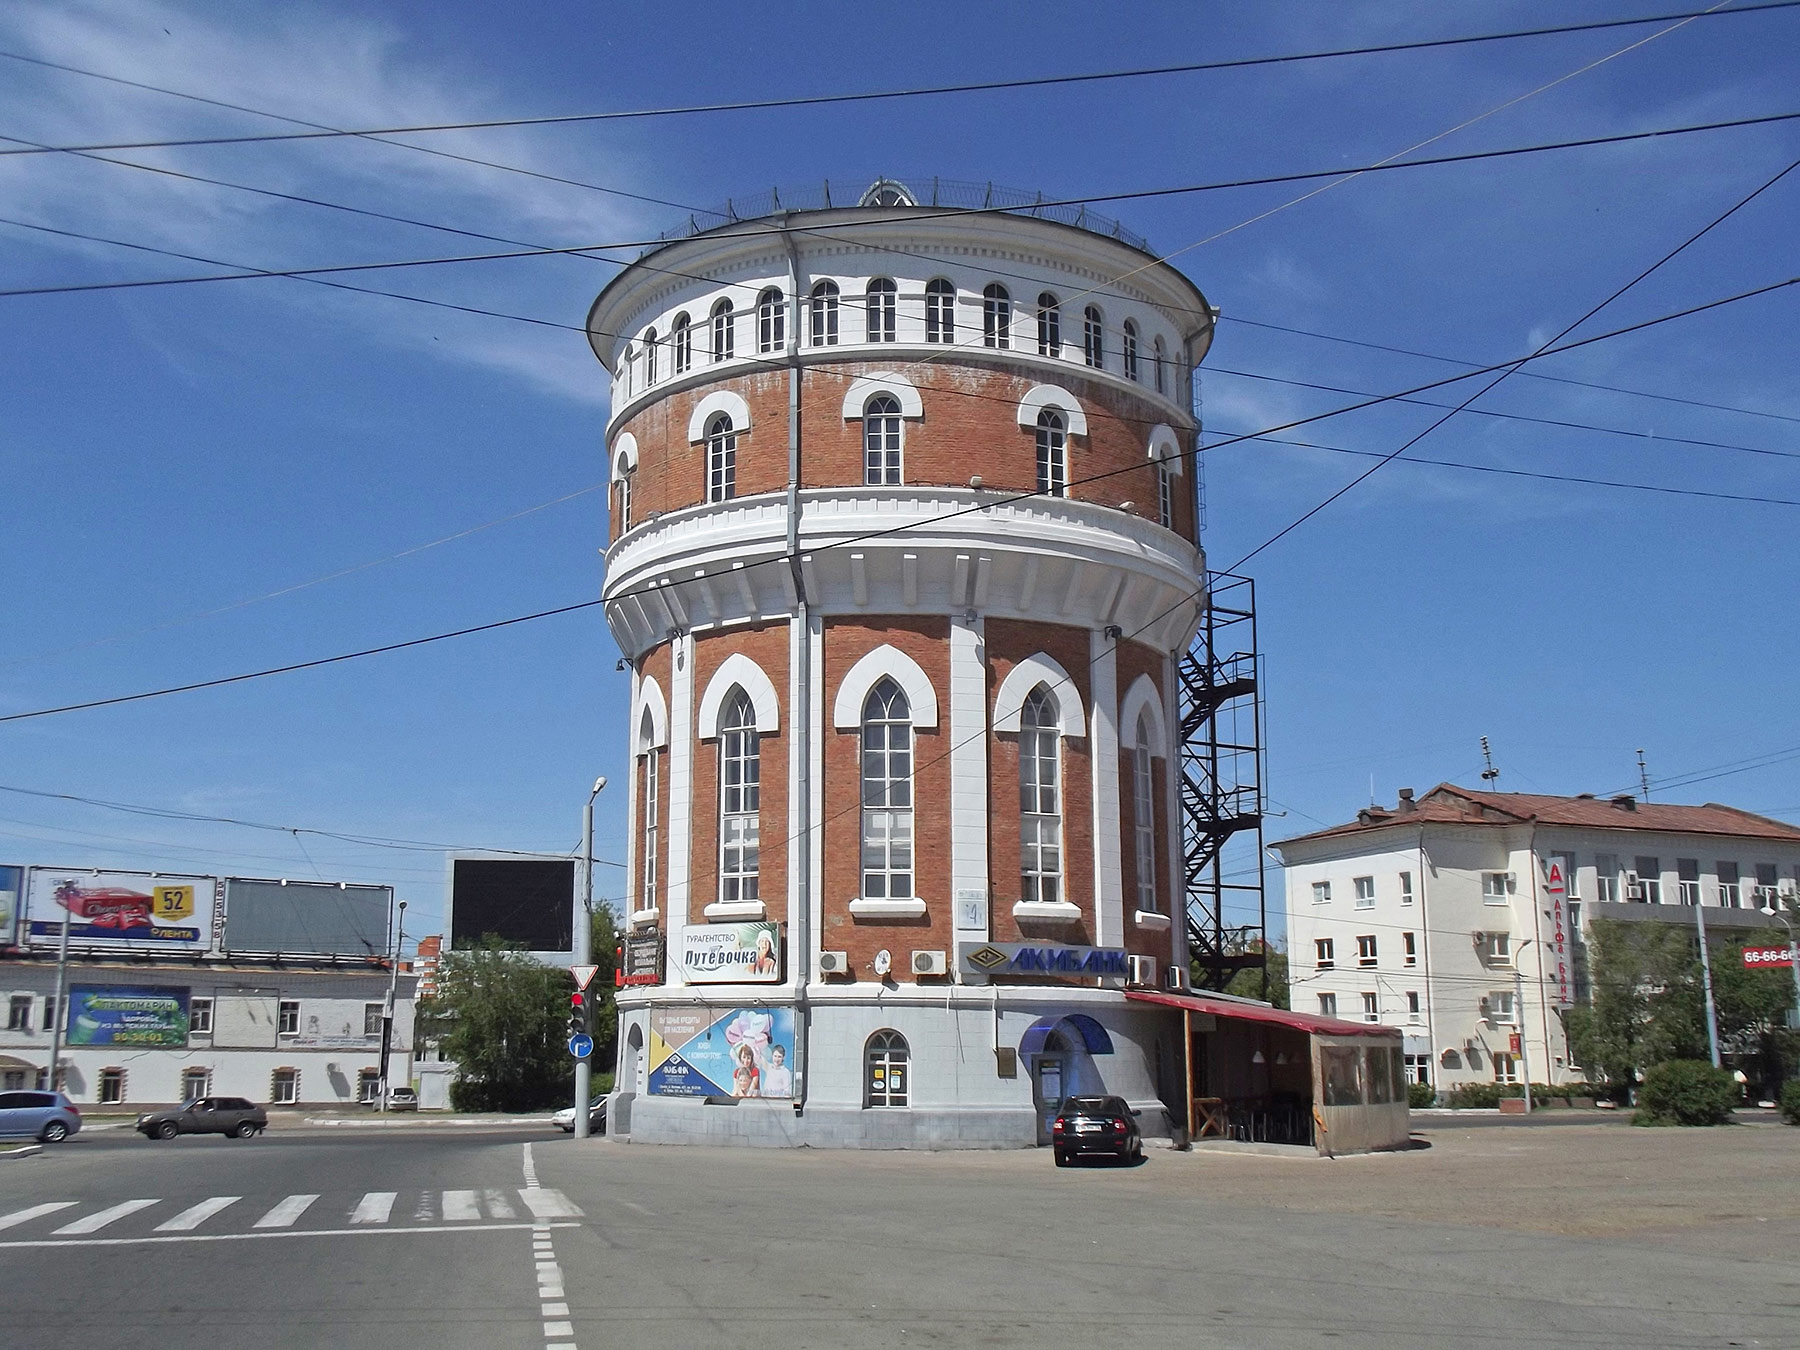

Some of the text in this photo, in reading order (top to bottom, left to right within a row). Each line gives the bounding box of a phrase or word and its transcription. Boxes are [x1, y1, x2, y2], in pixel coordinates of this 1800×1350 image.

[163, 890, 184, 911] 52
[160, 929, 194, 939] ЛЕНТА
[686, 933, 736, 943] ТУРАГЕНТСТВО
[1007, 947, 1129, 973] АКИБАНК
[102, 1001, 174, 1010] ЛАКТОМАРИН
